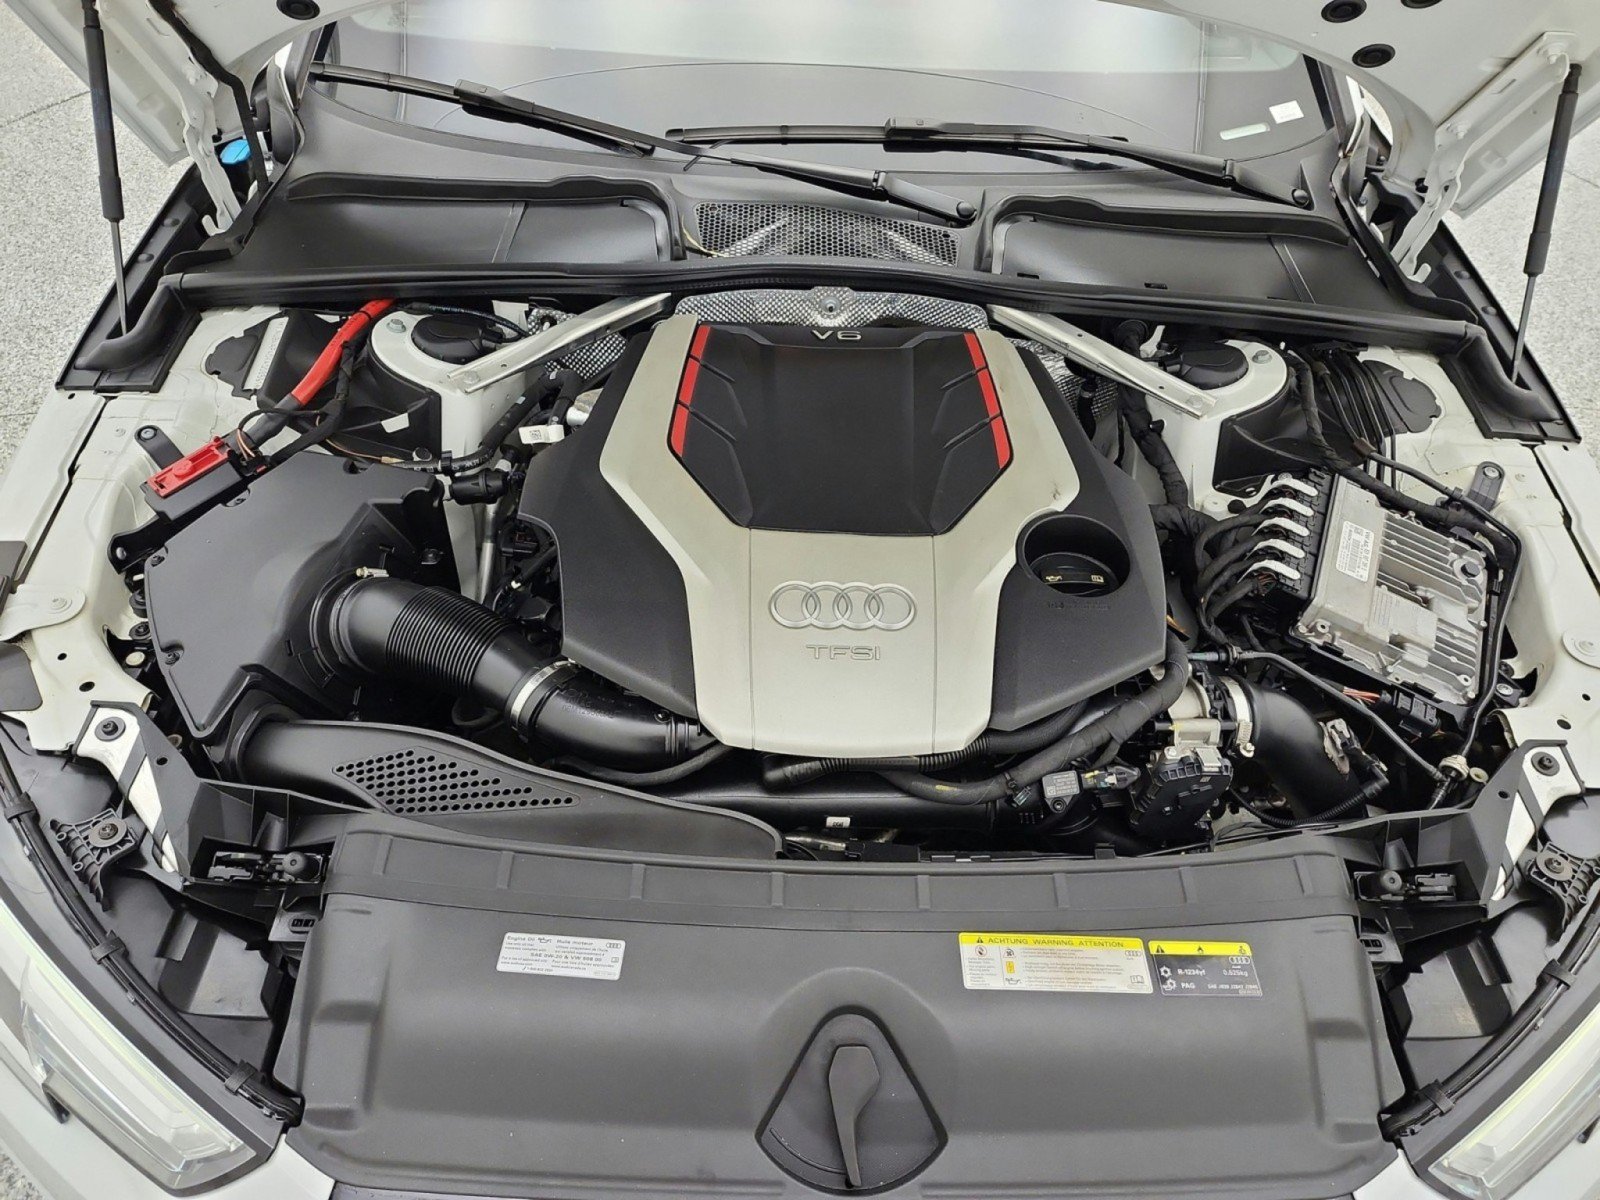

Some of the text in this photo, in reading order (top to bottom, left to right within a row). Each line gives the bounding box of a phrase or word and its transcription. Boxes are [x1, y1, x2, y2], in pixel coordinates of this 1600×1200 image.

[811, 329, 862, 340] V6
[805, 644, 881, 661] TFSI
[988, 937, 1124, 948] ACHTUNG WARNING ATTENTION
